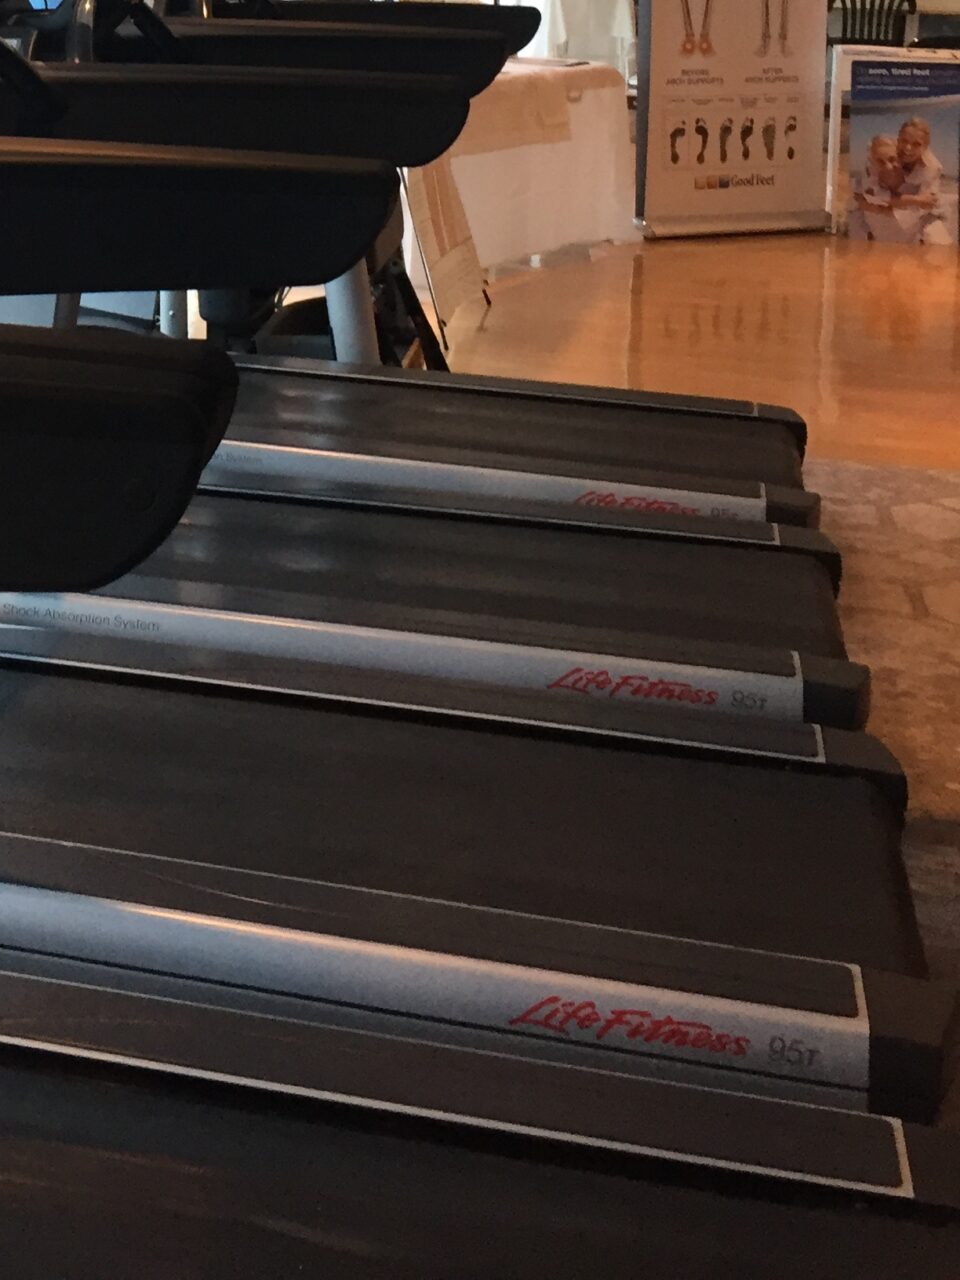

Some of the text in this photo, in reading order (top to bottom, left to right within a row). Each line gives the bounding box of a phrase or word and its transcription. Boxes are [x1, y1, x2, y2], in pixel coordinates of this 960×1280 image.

[731, 173, 775, 186] Good Feet
[574, 491, 618, 506] Life
[3, 604, 40, 619] Shock
[43, 607, 110, 626] Absorption
[114, 614, 160, 632] System
[547, 667, 612, 694] Life
[609, 675, 720, 705] Fitness
[509, 995, 822, 1067] Life Fitness 95T
